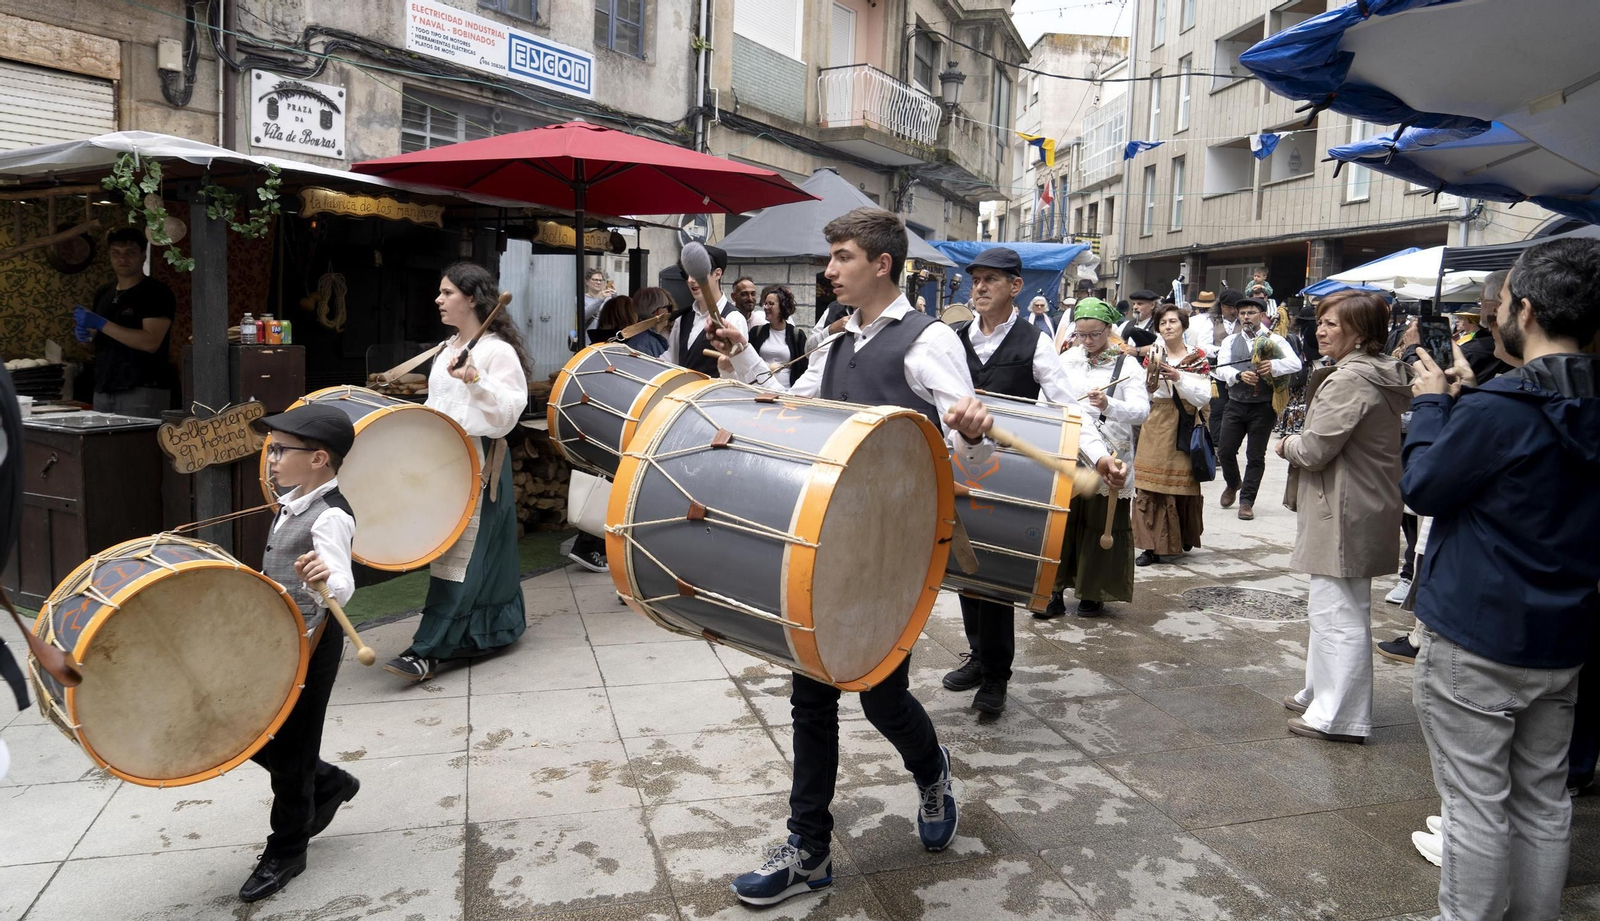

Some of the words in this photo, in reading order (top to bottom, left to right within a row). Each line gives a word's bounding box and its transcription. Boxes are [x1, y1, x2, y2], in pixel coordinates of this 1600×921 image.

[412, 3, 463, 26] ELECTRICIDAD
[465, 20, 506, 40] INDUSTRIAL
[420, 17, 445, 31] NAVAL
[453, 28, 495, 46] BOBINADOS
[415, 26, 430, 35] TODO
[450, 36, 471, 47] MOTORES
[415, 34, 451, 48] HERRAMIENTAS
[415, 41, 433, 50] PLATOS
[442, 48, 455, 56] MOTO
[287, 103, 312, 114] PRAZA
[262, 122, 283, 140] Vila
[286, 130, 297, 142] de
[299, 129, 336, 149] Bouzas
[310, 190, 320, 209] la
[361, 201, 372, 212] de
[376, 200, 392, 215] los
[542, 225, 568, 244] bollo
[168, 421, 209, 446] bollo
[180, 444, 200, 458] en
[201, 428, 246, 450] horno
[186, 454, 204, 471] de
